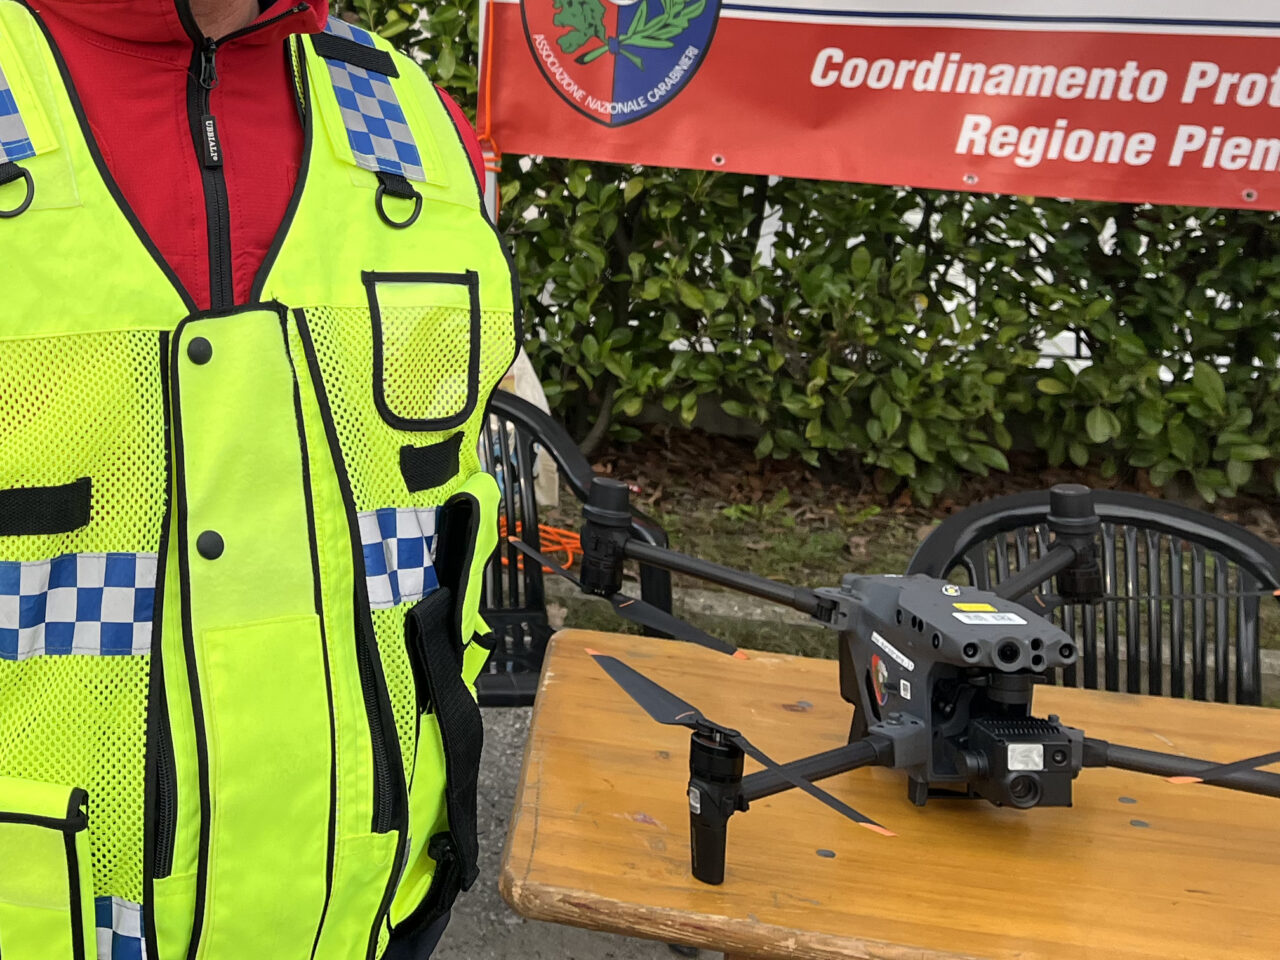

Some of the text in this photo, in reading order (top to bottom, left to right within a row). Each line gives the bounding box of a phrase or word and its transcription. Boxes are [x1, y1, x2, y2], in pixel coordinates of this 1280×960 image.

[532, 33, 700, 115] ASSOCIAZIONE NAZIONALE CARABINIERI
[809, 46, 1169, 104] Coordinamento
[955, 113, 1157, 169] Regione
